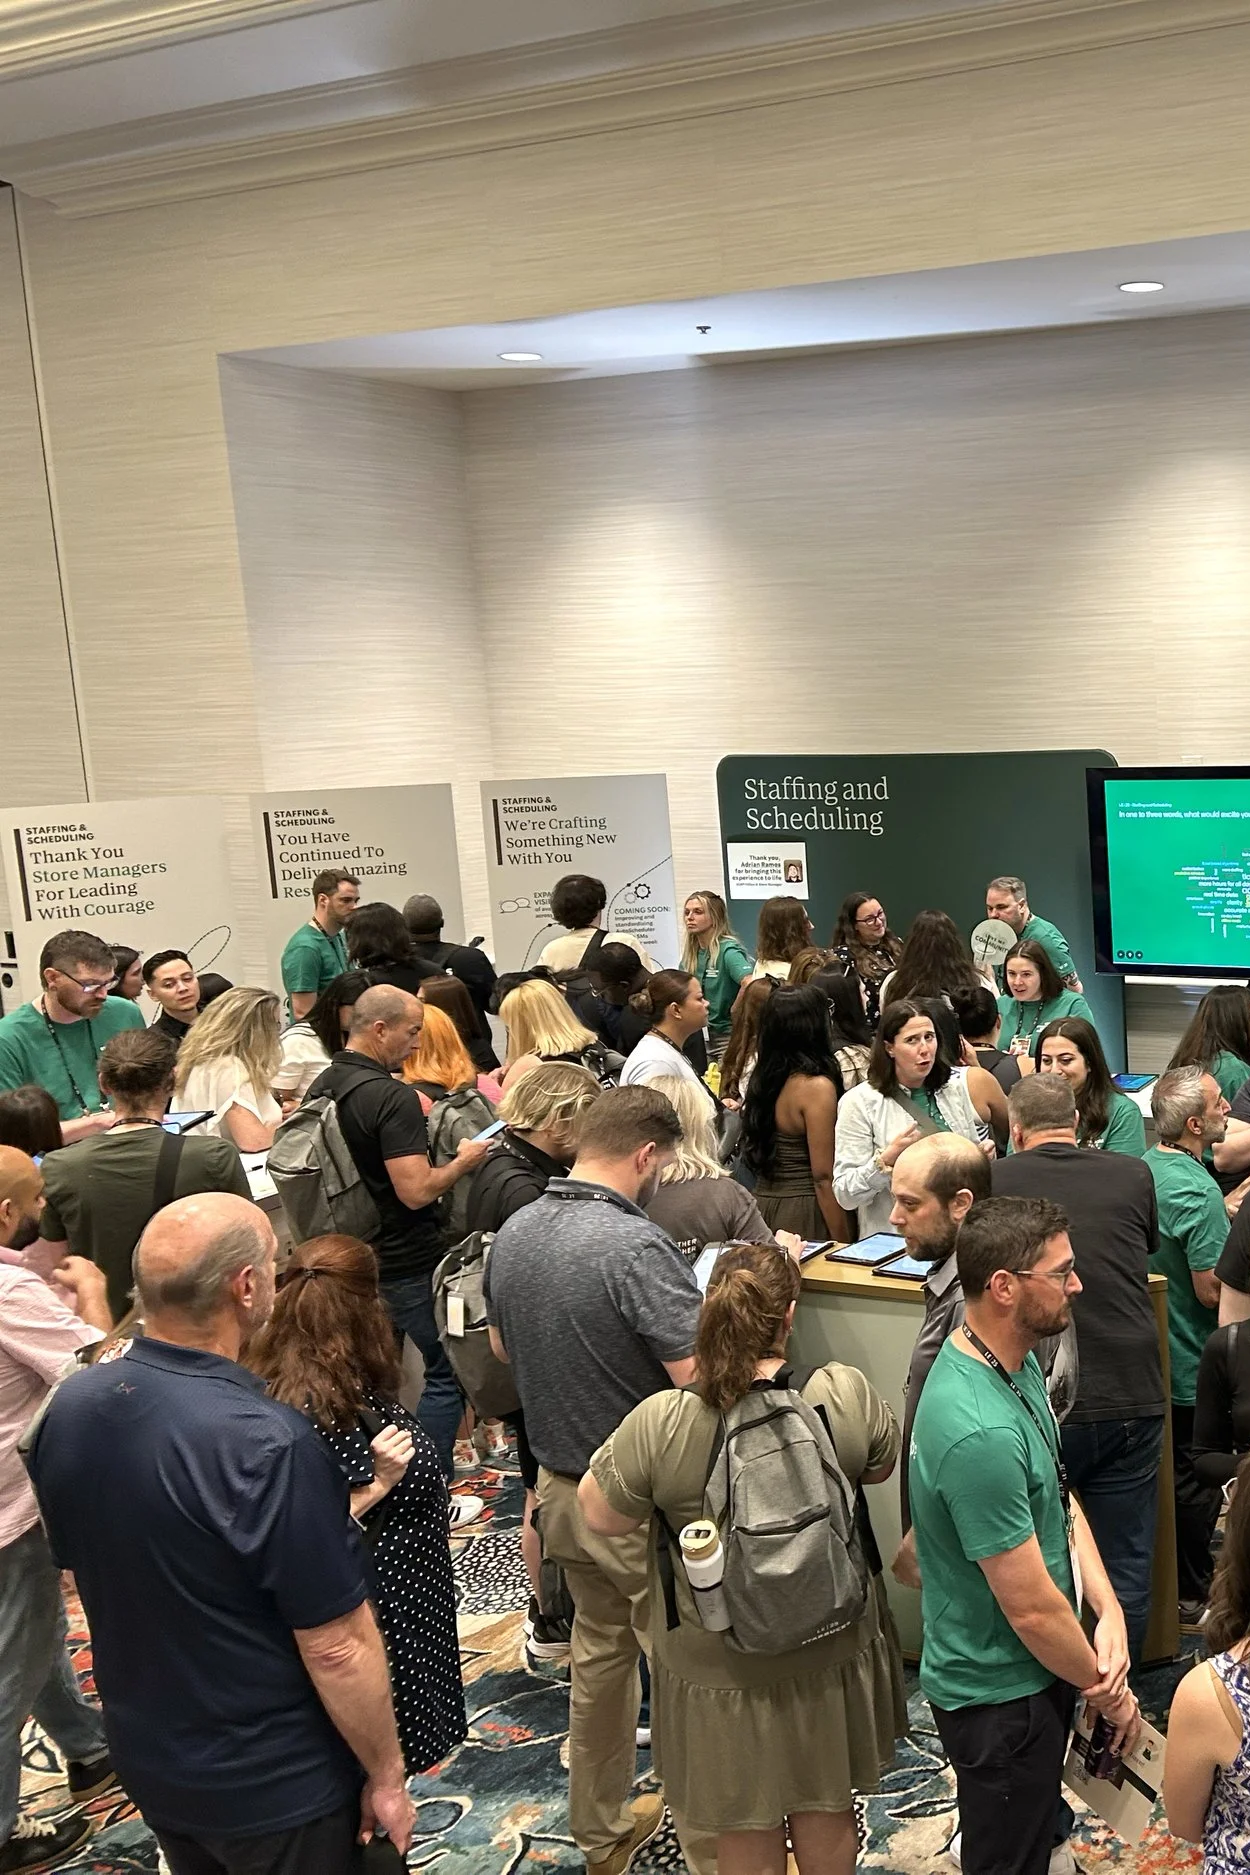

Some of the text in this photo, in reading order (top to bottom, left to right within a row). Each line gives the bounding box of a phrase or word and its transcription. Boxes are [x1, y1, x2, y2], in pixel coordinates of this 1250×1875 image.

[744, 776, 889, 806] Staffing and
[502, 796, 543, 805] STAFFING
[274, 809, 320, 818] STAFFING
[503, 804, 558, 814] SCHEDULING
[274, 817, 336, 828] SCHEDULING
[504, 816, 607, 832] We're Crafting
[746, 807, 883, 836] Scheduling
[26, 824, 86, 835] STAFFING &
[26, 832, 94, 844] SCHEDULING
[277, 832, 350, 846] You Have
[506, 833, 616, 849] Something New
[30, 848, 124, 864] Thank You
[280, 846, 384, 864] Continued To
[507, 852, 572, 865] With You
[33, 862, 167, 884] Store Managers
[282, 866, 328, 881] Deliv
[36, 882, 138, 902] For Leading
[38, 900, 154, 920] With Courage
